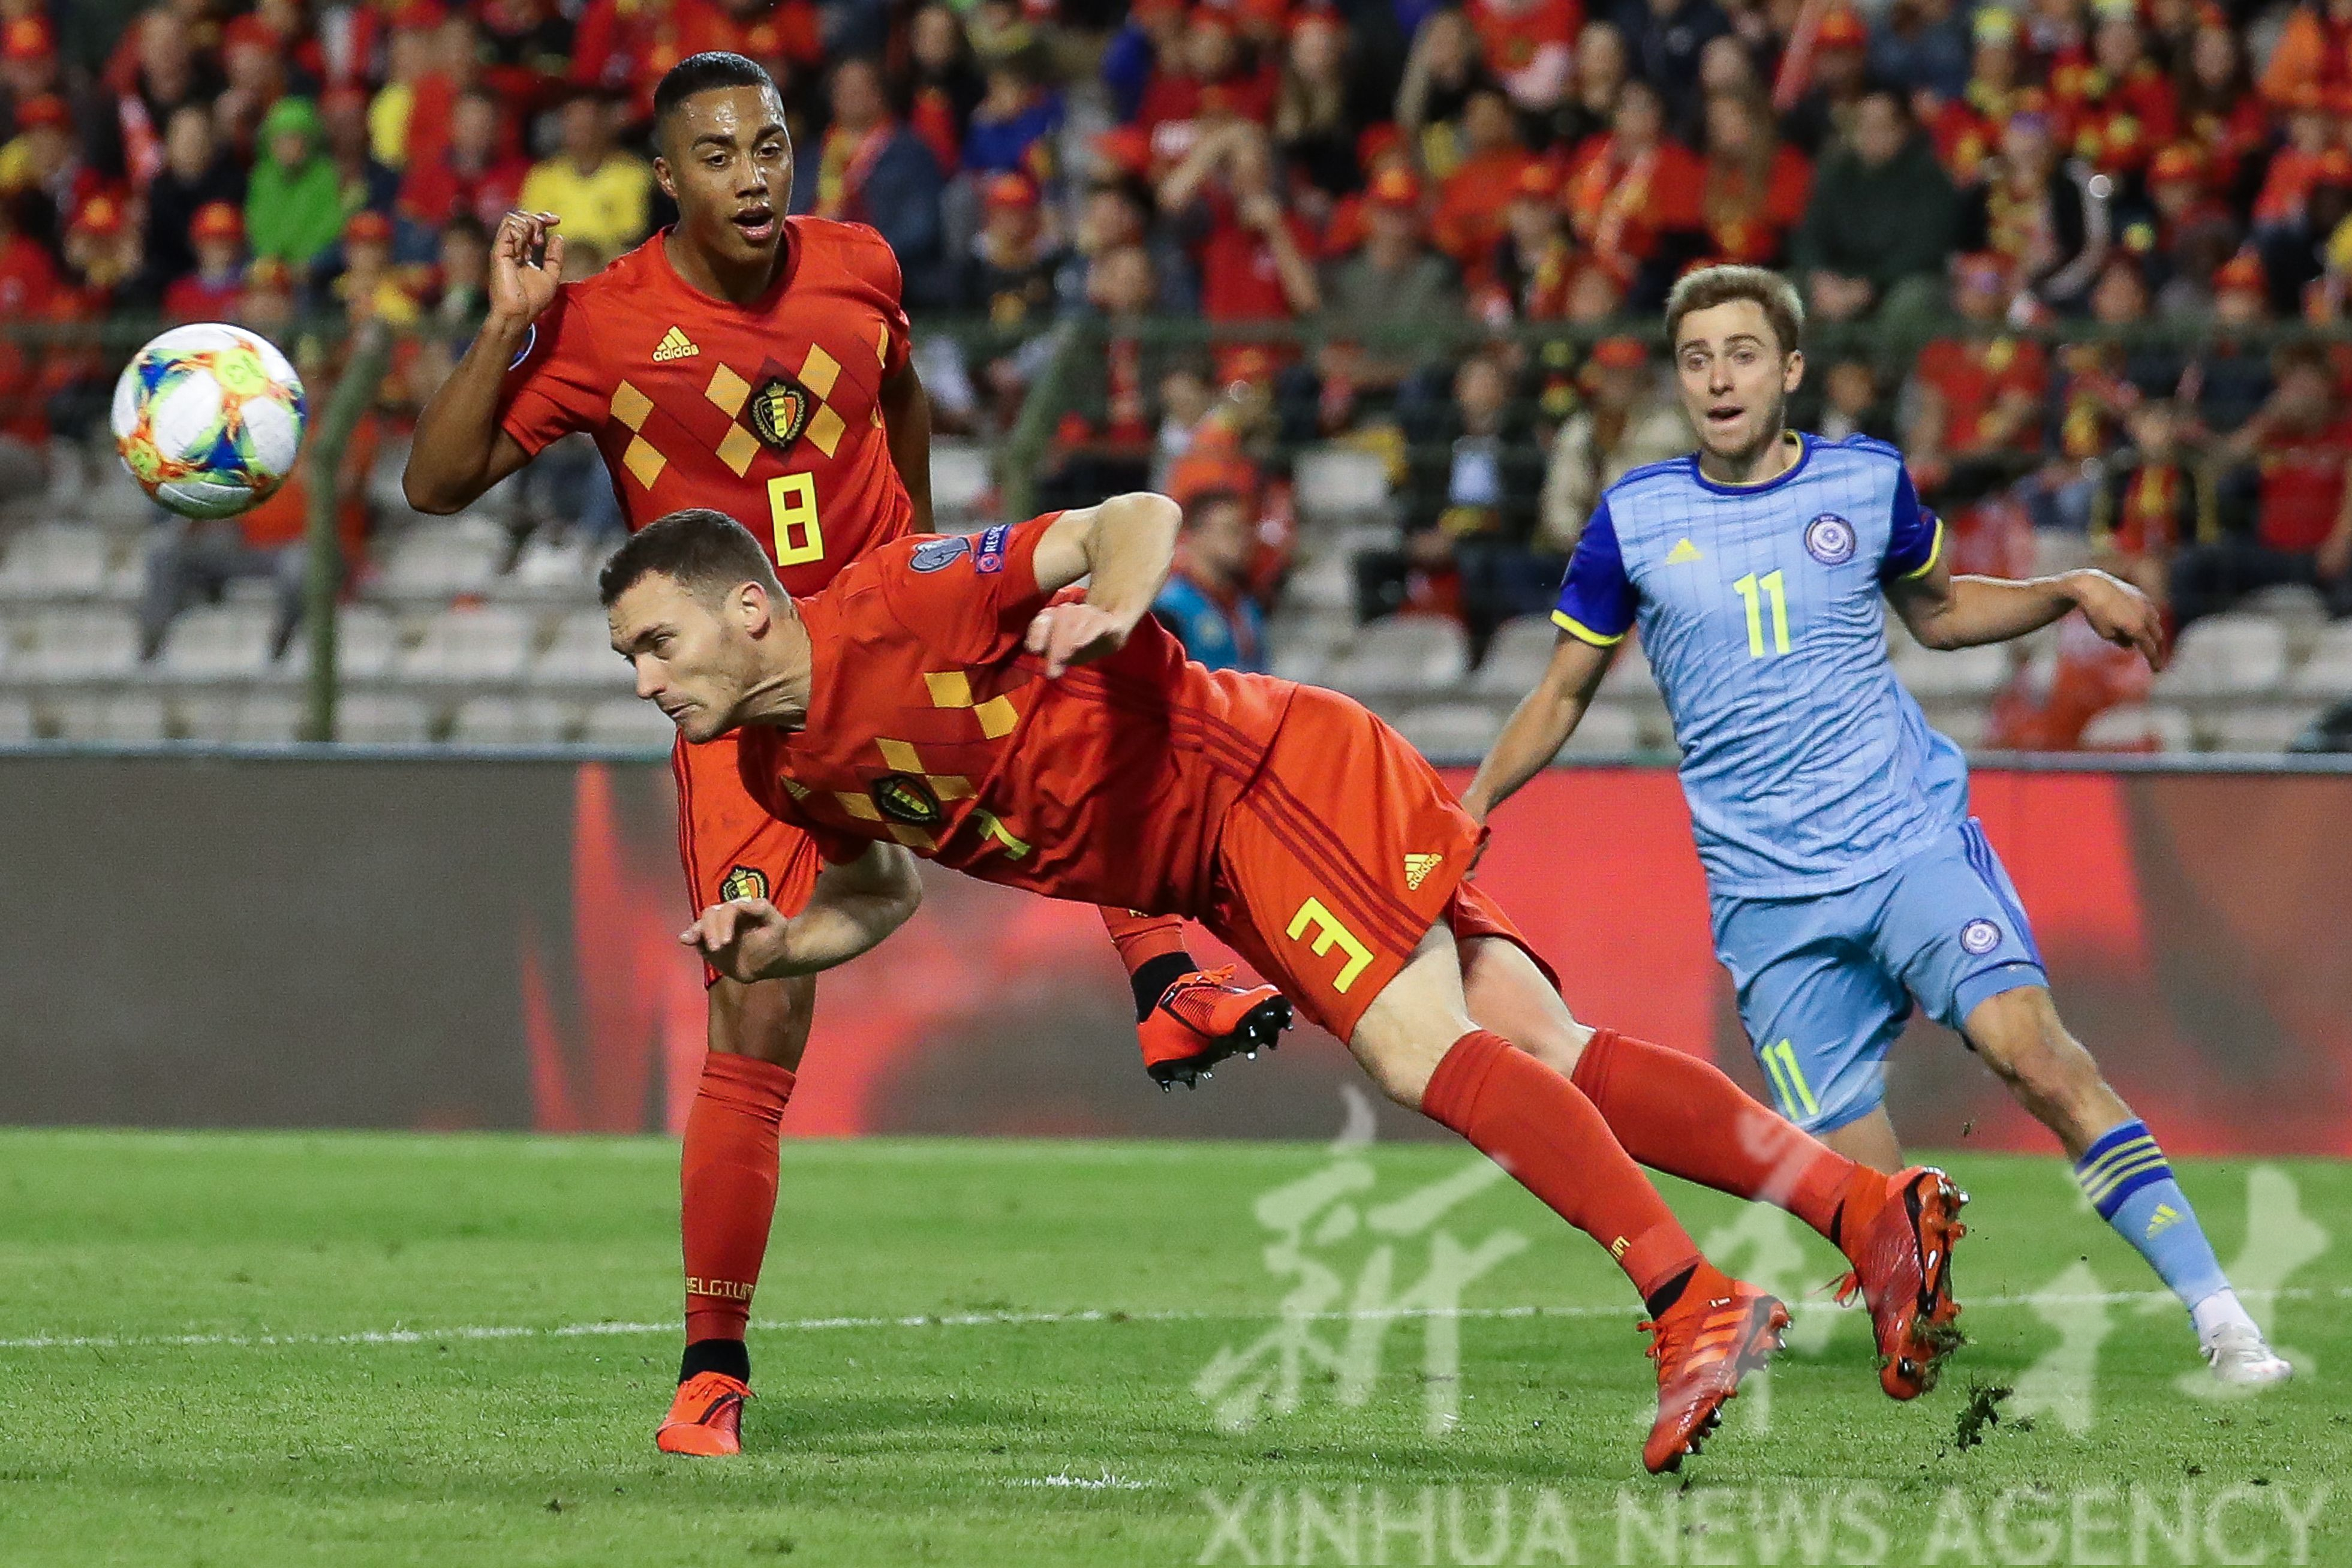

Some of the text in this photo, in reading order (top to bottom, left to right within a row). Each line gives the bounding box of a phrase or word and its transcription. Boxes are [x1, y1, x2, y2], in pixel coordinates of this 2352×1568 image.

[652, 344, 699, 362] adidas
[767, 471, 824, 567] 8
[1733, 569, 1790, 658] 11
[1286, 896, 1374, 994] 3
[1761, 1037, 1819, 1120] 11
